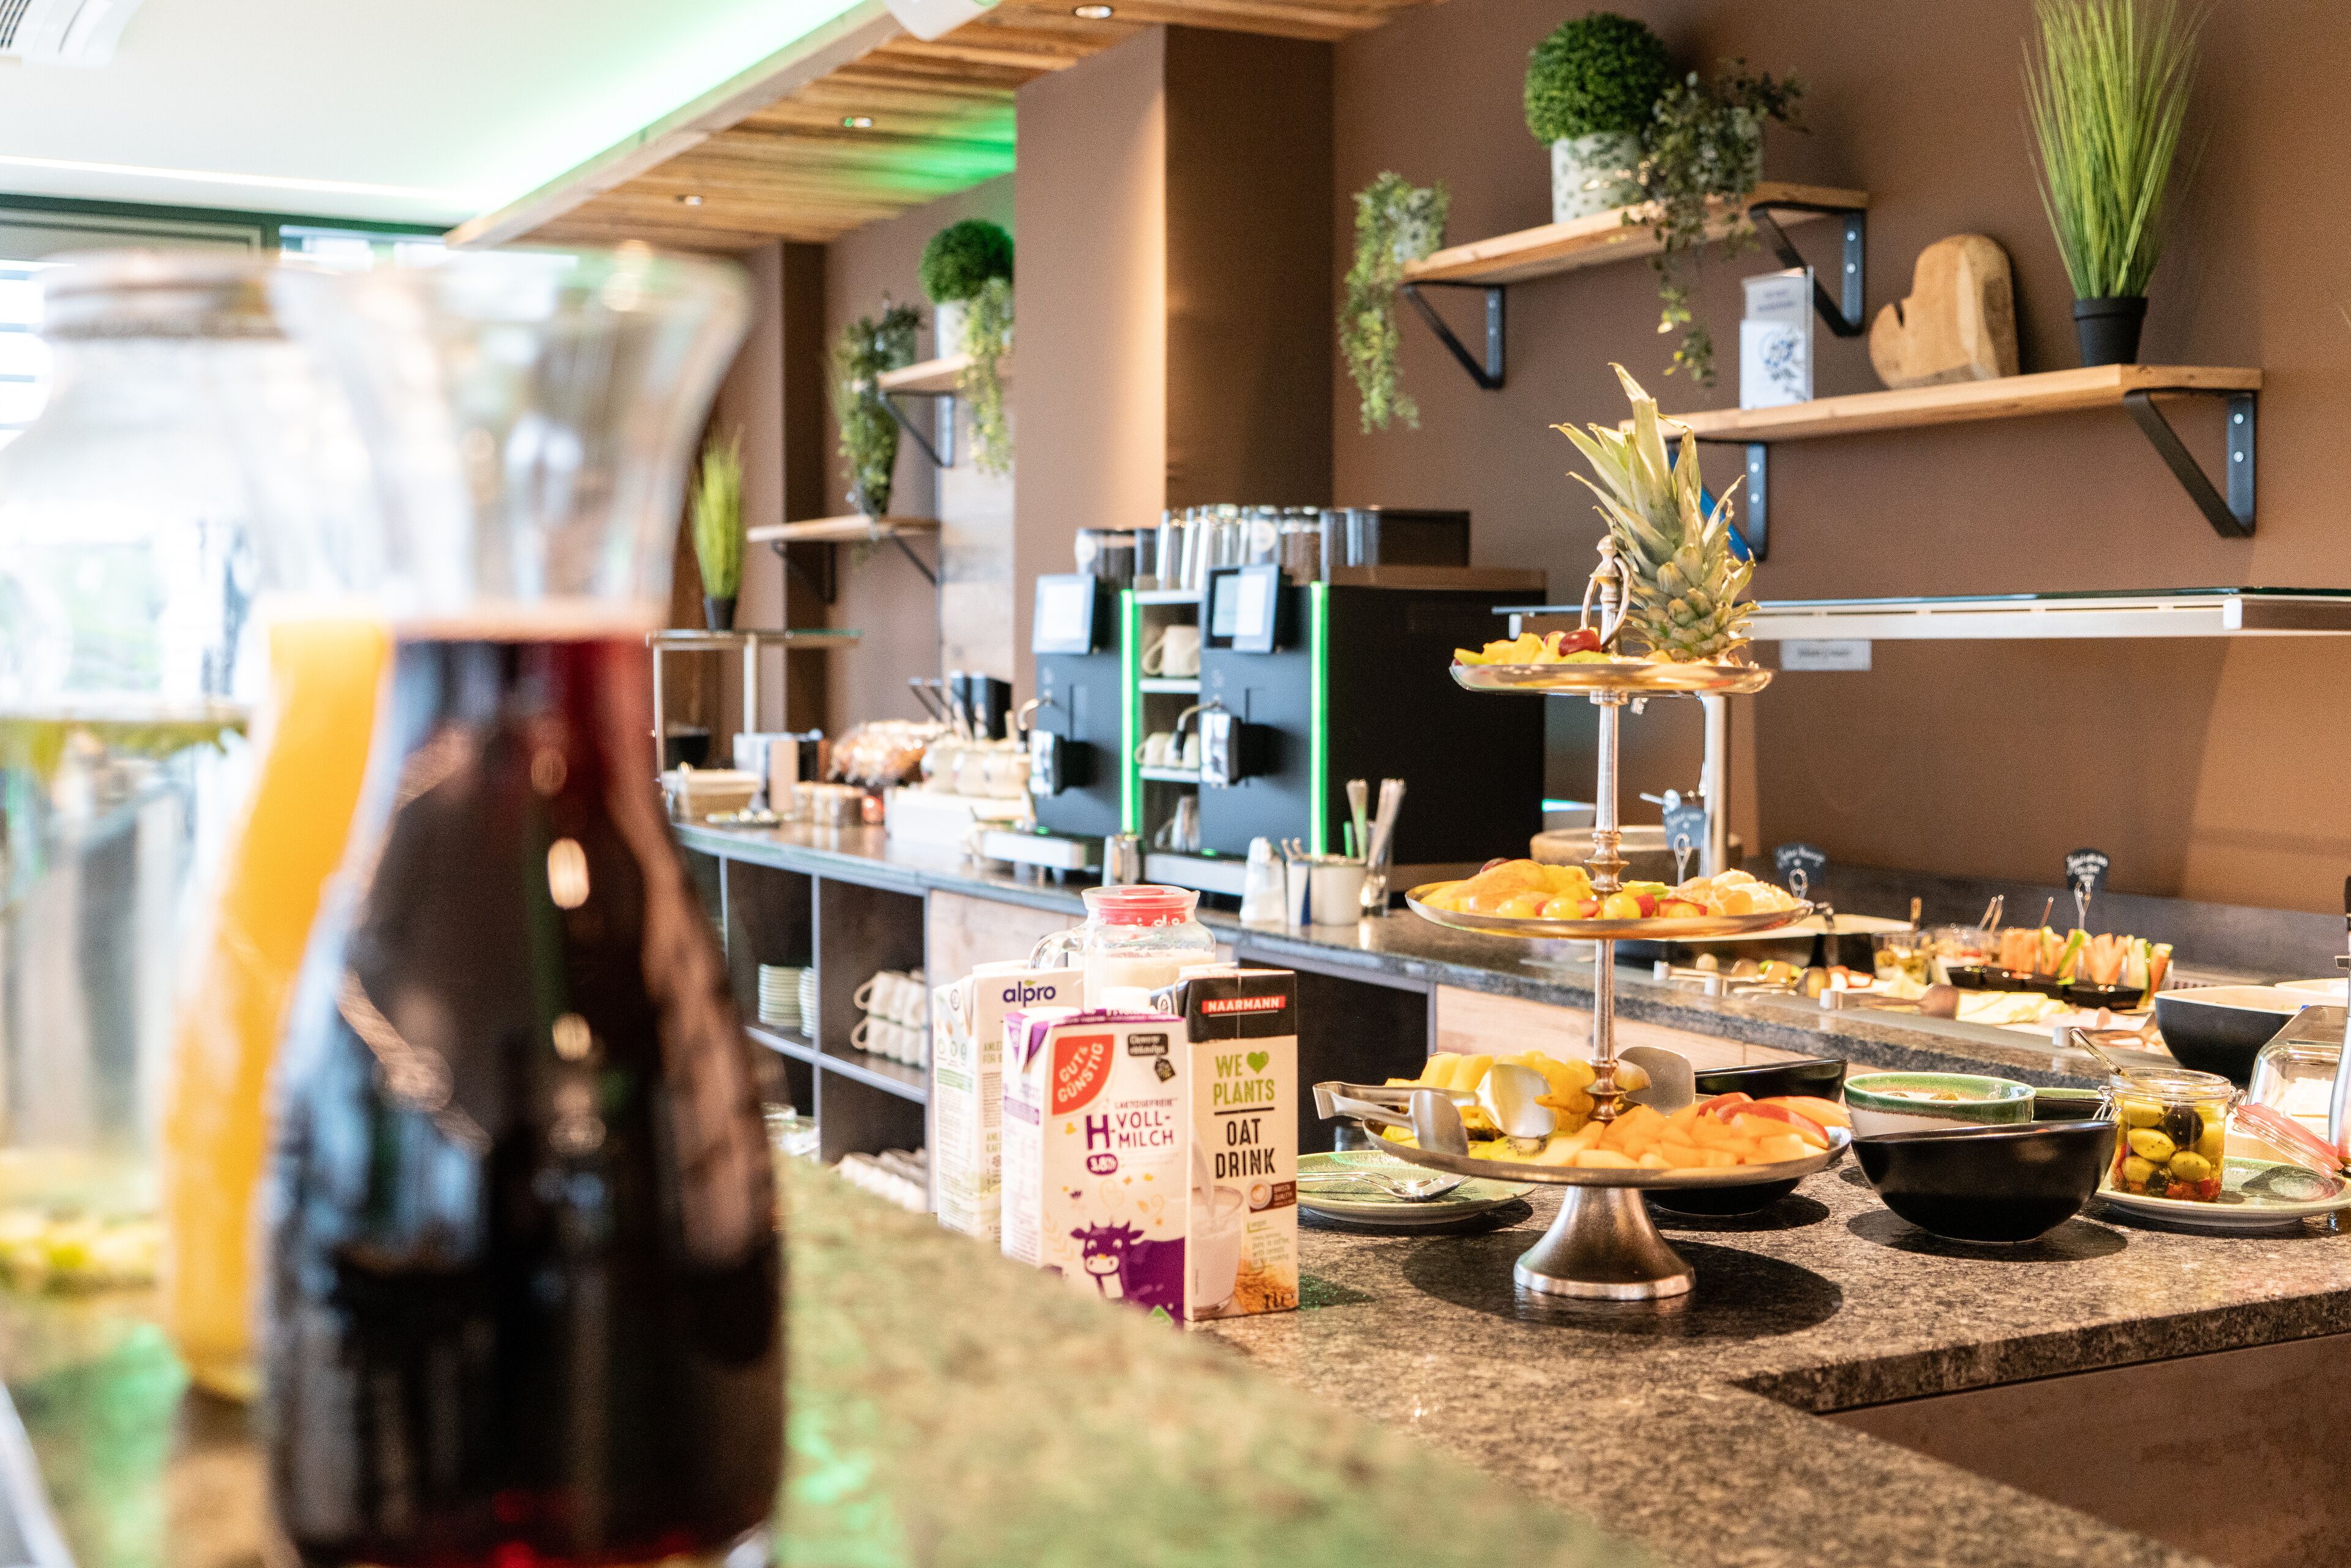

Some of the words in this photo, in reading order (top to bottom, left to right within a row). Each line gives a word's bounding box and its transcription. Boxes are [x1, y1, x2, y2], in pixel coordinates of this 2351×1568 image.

[1003, 981, 1056, 1008] alpro
[1208, 997, 1280, 1012] NAARMANN
[1057, 1042, 1104, 1102] GÜNSTIG
[1215, 1054, 1242, 1078] WE
[1213, 1079, 1275, 1106] PLANTS
[1117, 1111, 1171, 1128] VOLL-
[1226, 1118, 1261, 1146] OAT
[1119, 1130, 1174, 1148] MILCH
[1215, 1147, 1275, 1179] DRINK
